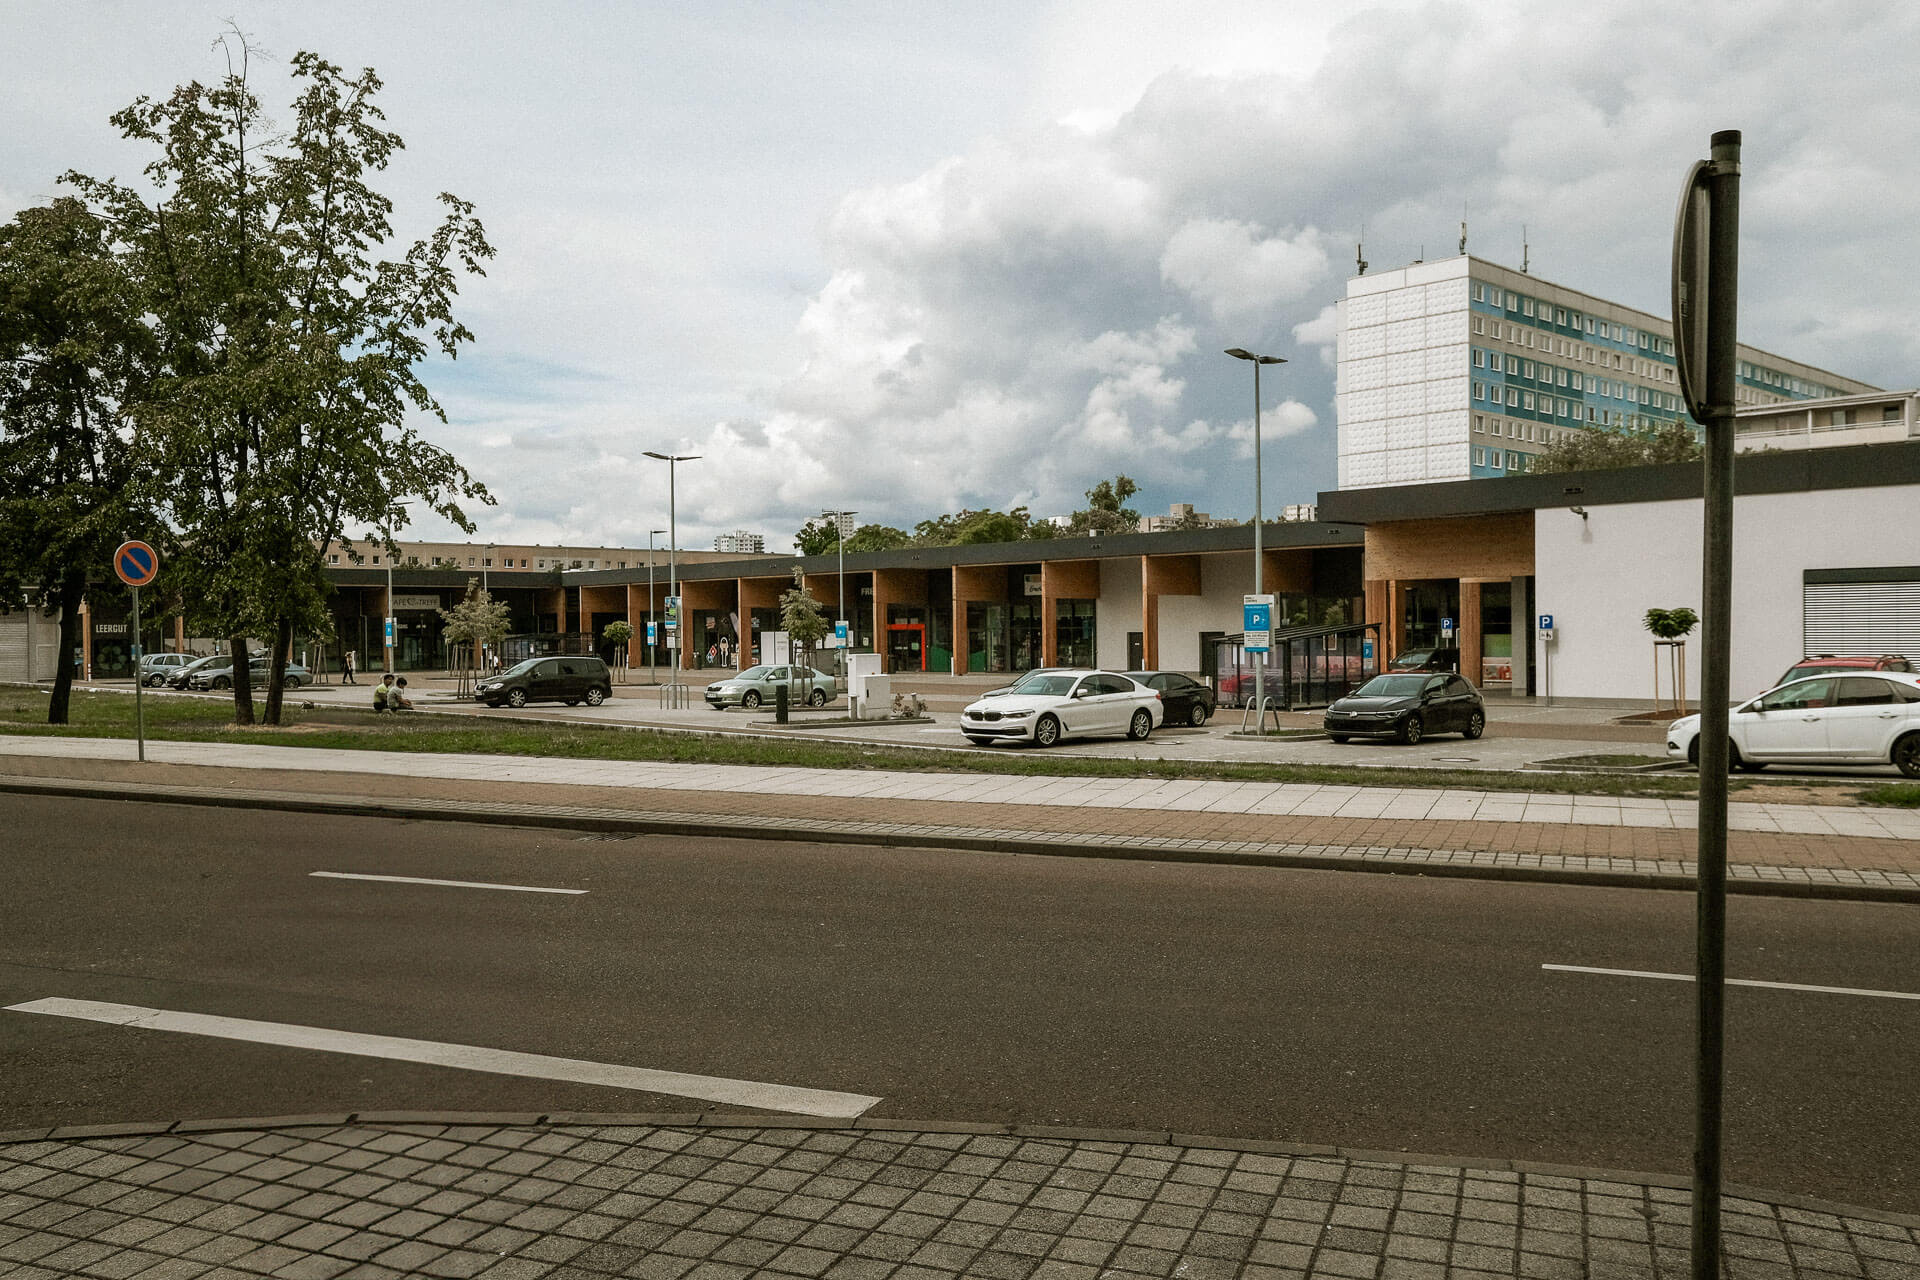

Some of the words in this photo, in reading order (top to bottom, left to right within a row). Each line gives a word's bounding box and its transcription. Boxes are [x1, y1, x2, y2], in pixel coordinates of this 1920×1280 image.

[1253, 614, 1260, 625] P
[1443, 619, 1450, 629] P
[1542, 617, 1550, 628] P
[95, 624, 128, 633] LEERGUT
